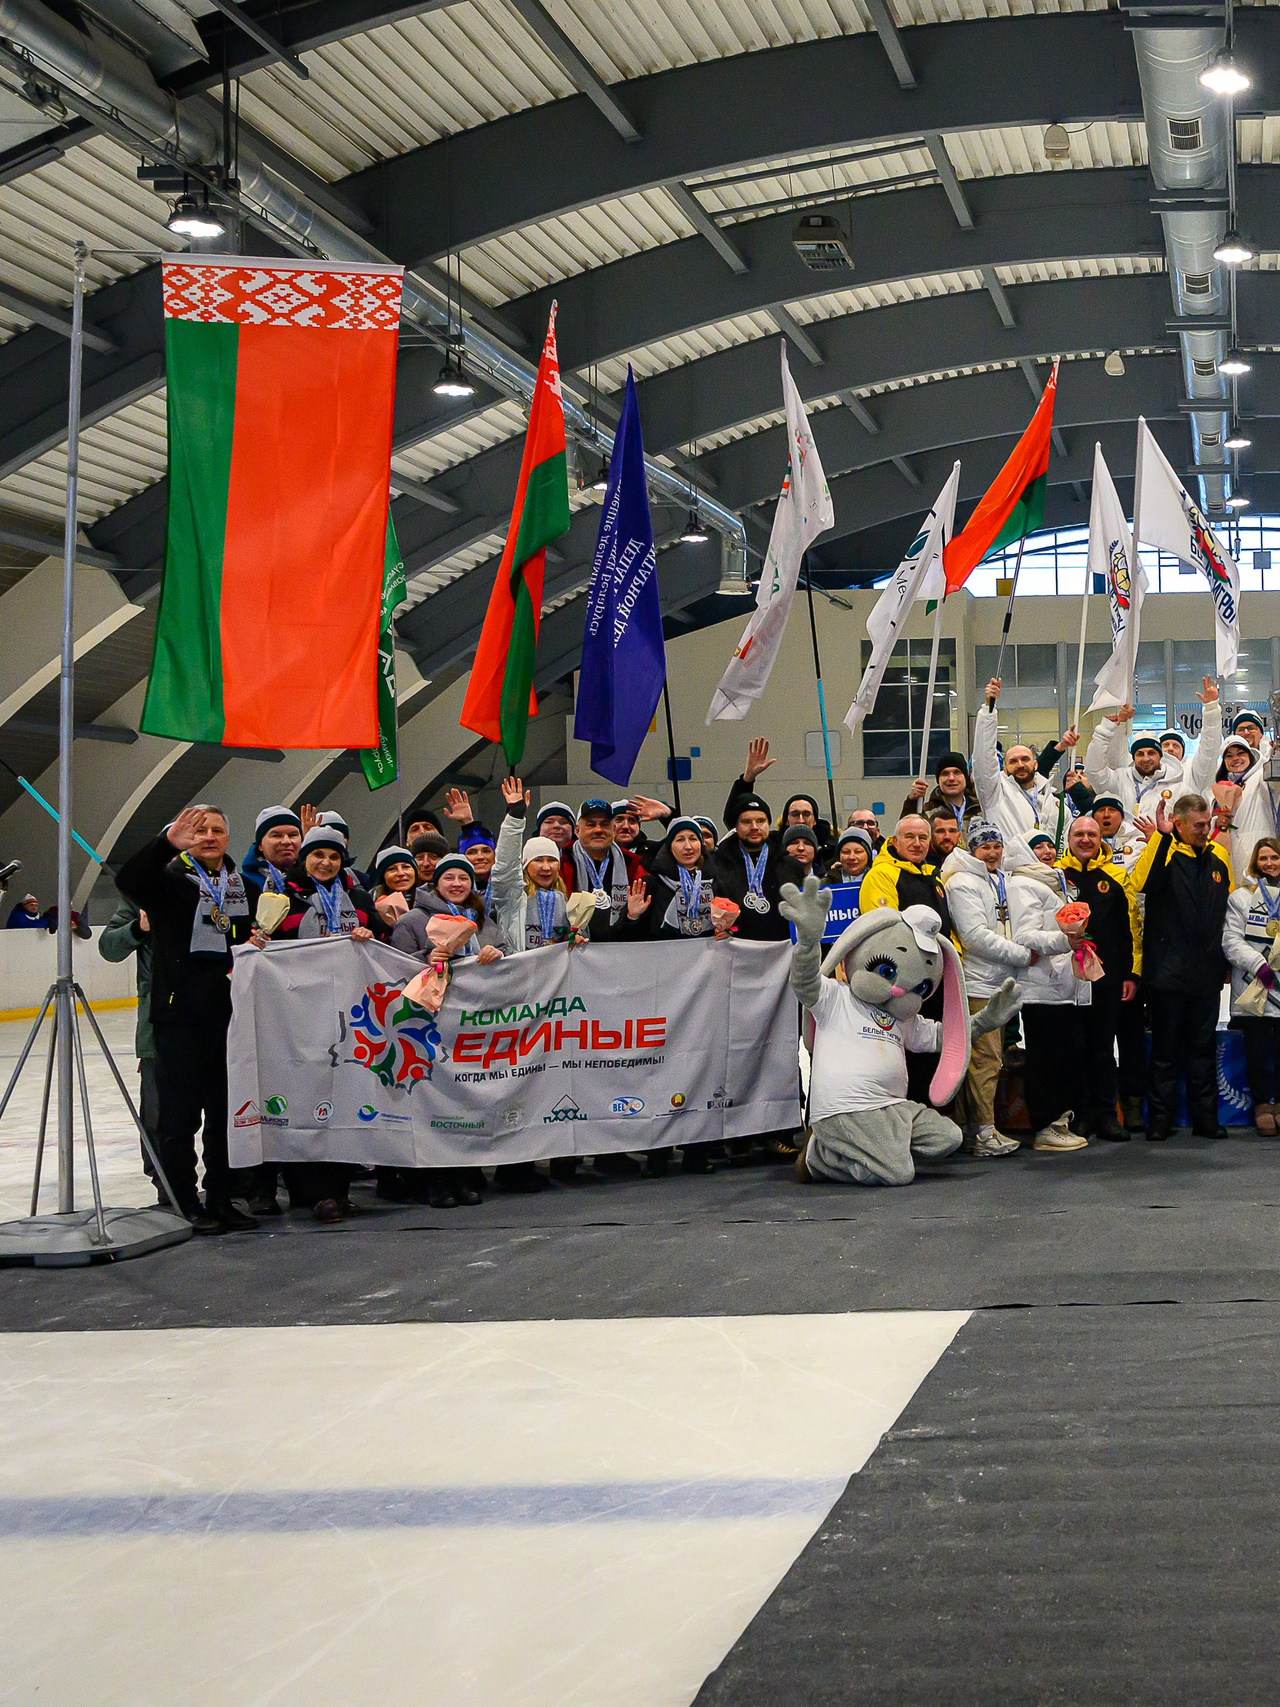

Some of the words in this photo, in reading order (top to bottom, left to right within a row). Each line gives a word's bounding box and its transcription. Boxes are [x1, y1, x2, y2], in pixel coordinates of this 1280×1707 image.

[459, 996, 586, 1027] КОМАНДА
[452, 1016, 667, 1070] ЕДИНЫЕ
[862, 1026, 885, 1036] БЕЛЫЕ
[454, 1071, 487, 1083] КОГДА
[489, 1069, 508, 1080] МЫ
[511, 1062, 546, 1078] ЕДИНЫ
[562, 1059, 582, 1070] МЫ
[584, 1055, 665, 1069] НЕПОБЕДИМЫ!
[430, 1120, 485, 1129] ВОСТОЧНЫЙ
